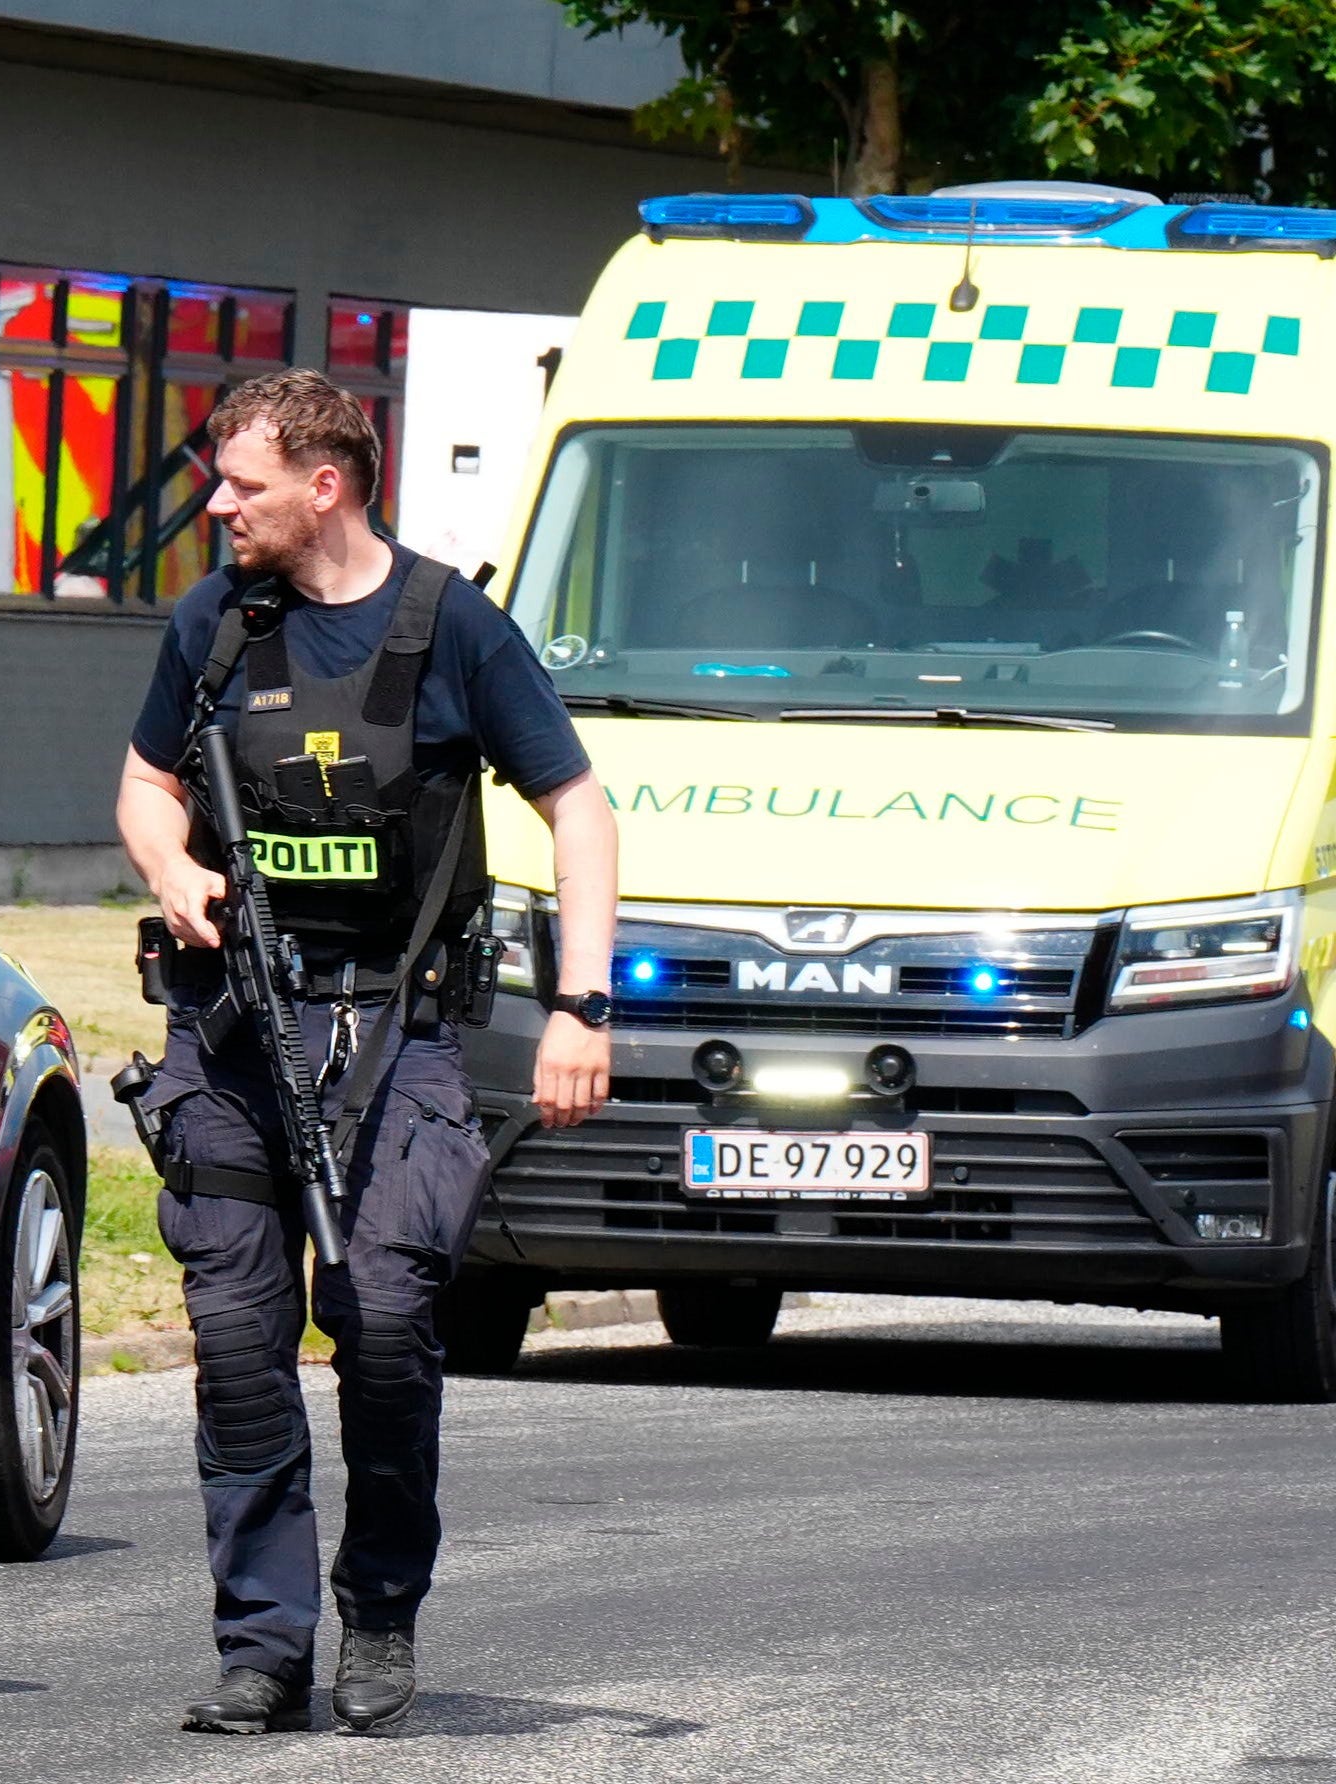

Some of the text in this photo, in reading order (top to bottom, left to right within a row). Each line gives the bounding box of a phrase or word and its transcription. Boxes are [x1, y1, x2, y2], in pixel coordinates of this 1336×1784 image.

[736, 959, 893, 994] MAN
[718, 1142, 918, 1180] DE 97 929
